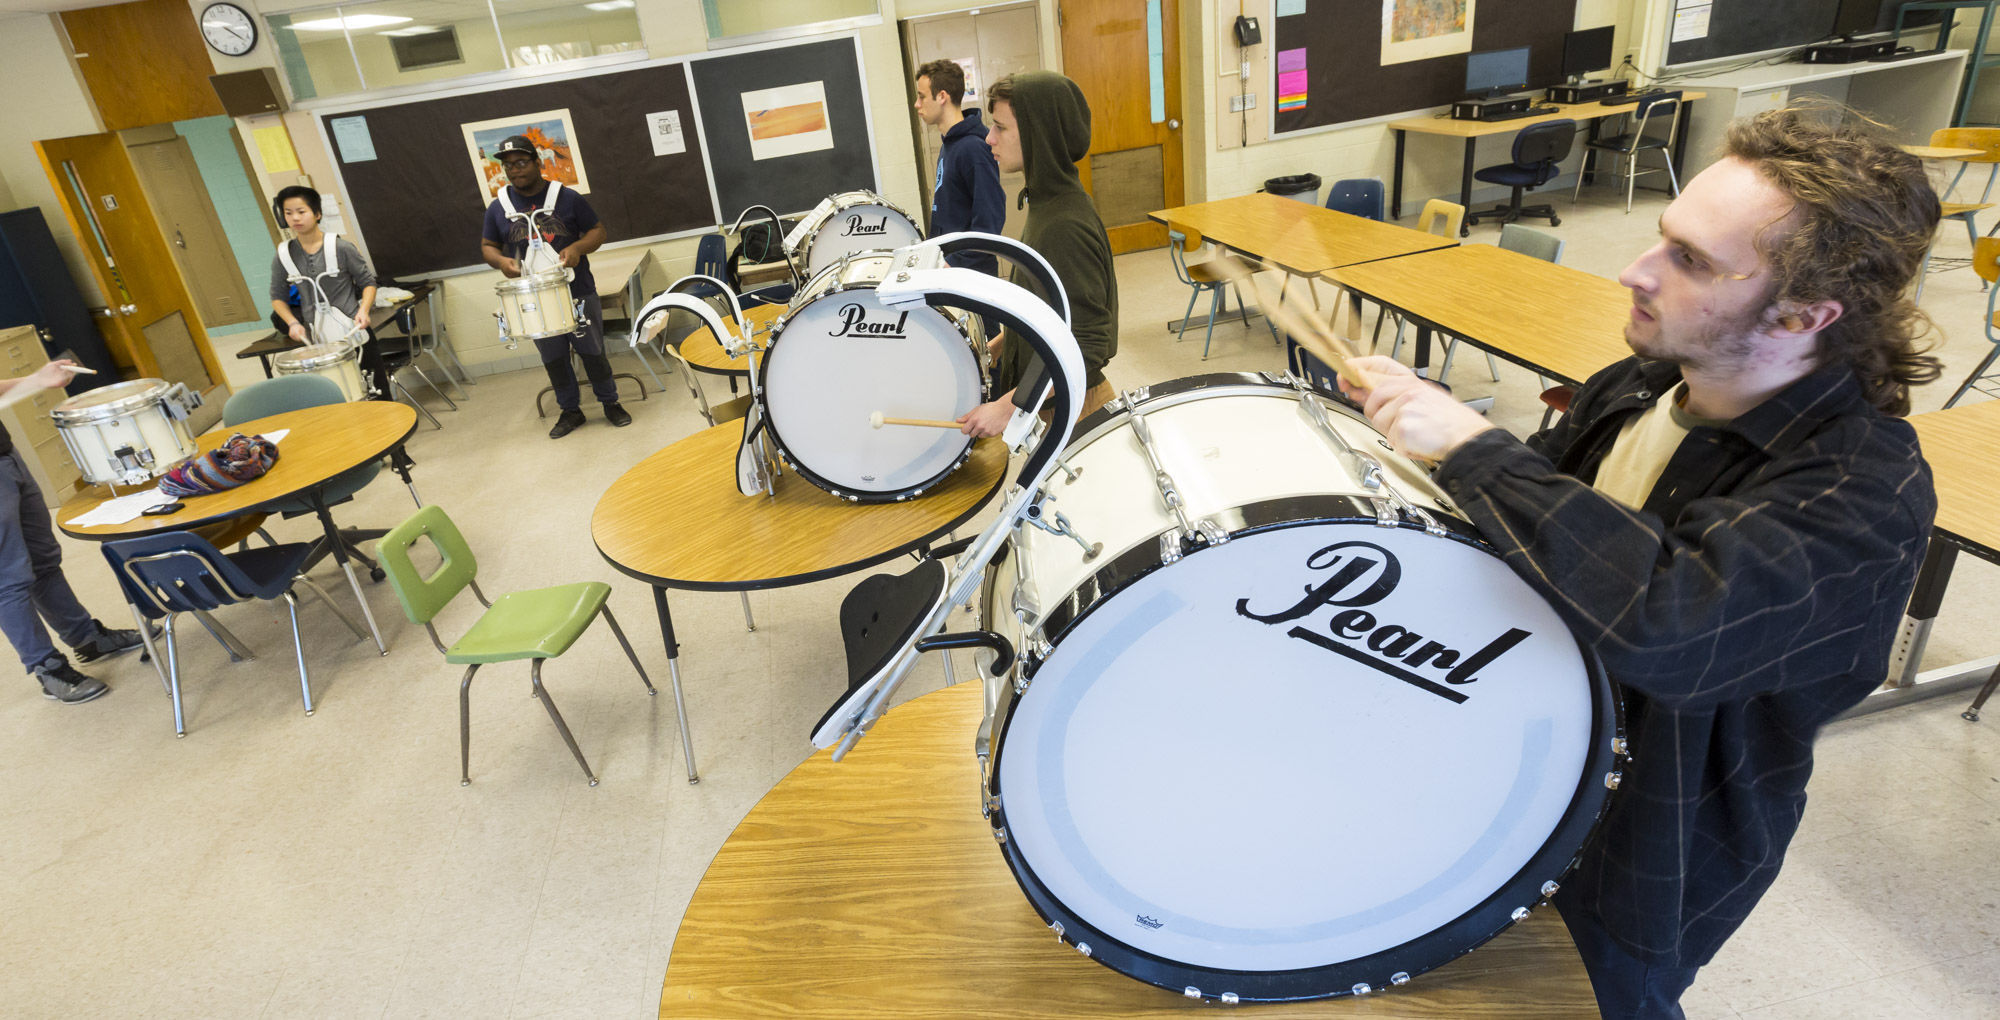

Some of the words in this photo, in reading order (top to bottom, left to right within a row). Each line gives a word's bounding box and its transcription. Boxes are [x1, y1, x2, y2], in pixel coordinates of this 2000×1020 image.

[840, 214, 888, 237] Pearl
[828, 302, 910, 337] Pearl
[1236, 541, 1533, 688] Pearl
